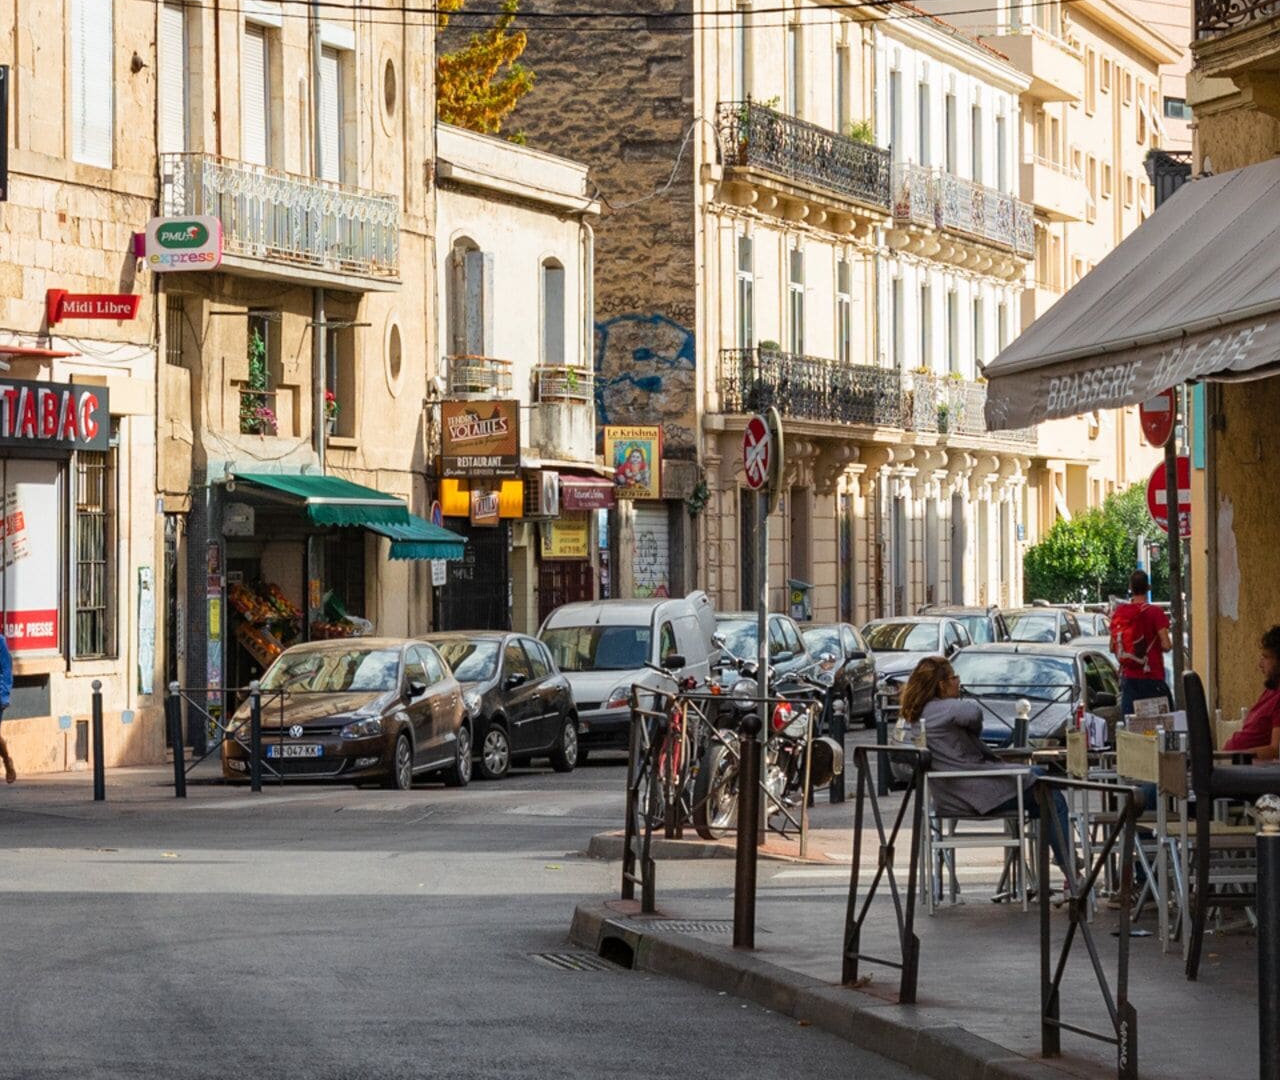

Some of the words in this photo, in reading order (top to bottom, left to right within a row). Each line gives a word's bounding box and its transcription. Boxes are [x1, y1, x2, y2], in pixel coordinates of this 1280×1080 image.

[160, 231, 186, 242] PMU
[150, 250, 214, 267] express
[62, 300, 93, 313] Midi
[96, 300, 131, 314] Libre
[1046, 360, 1143, 412] BRASSERIE
[449, 417, 508, 439] VOLAILLES
[607, 429, 618, 437] Le
[620, 428, 657, 437] Krishna
[457, 456, 502, 467] RESTAURANT
[4, 622, 24, 638] ABAC
[26, 621, 54, 637] PRESSE
